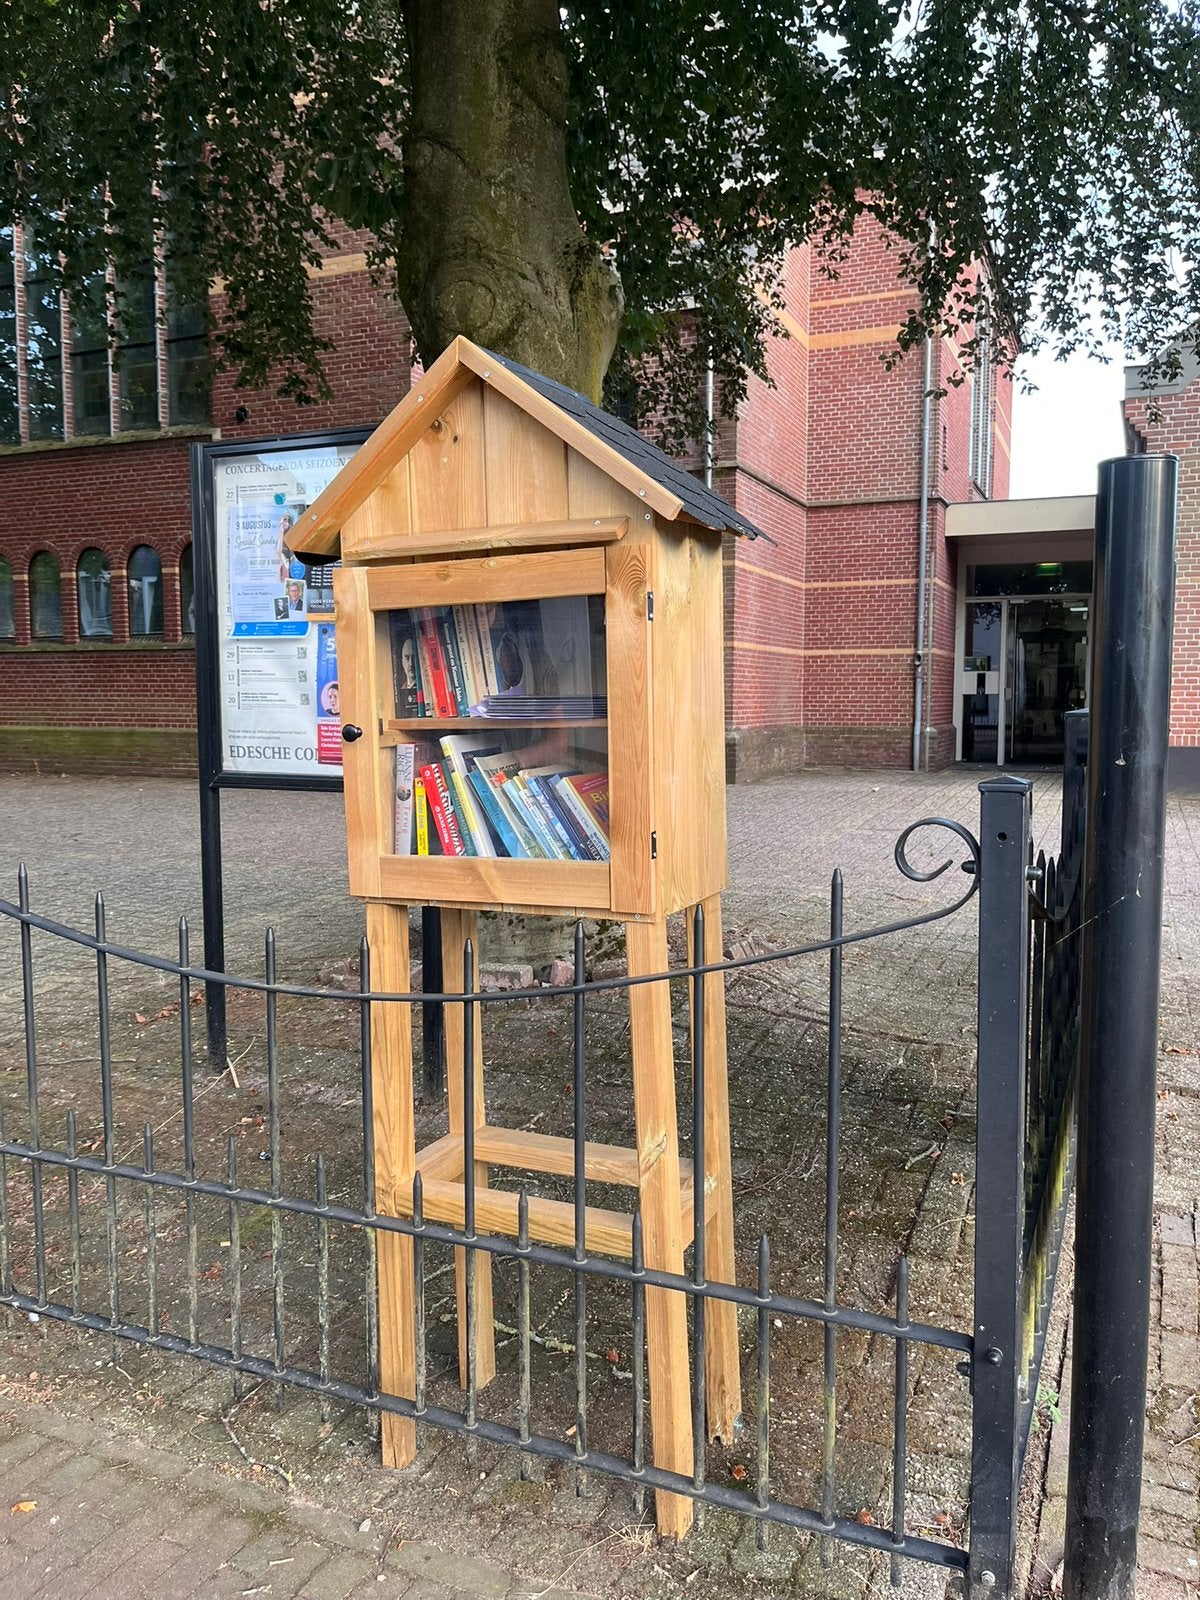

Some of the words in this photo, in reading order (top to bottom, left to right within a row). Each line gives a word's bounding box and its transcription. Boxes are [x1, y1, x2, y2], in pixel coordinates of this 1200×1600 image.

[225, 461, 304, 475] CONCERTAGENDA
[306, 457, 345, 470] SEIZOEN
[242, 519, 272, 530] AUGUSTUS
[227, 673, 235, 681] 13
[229, 745, 291, 760] EDESCHE
[397, 753, 405, 775] RICE
[405, 746, 413, 784] LUANNE
